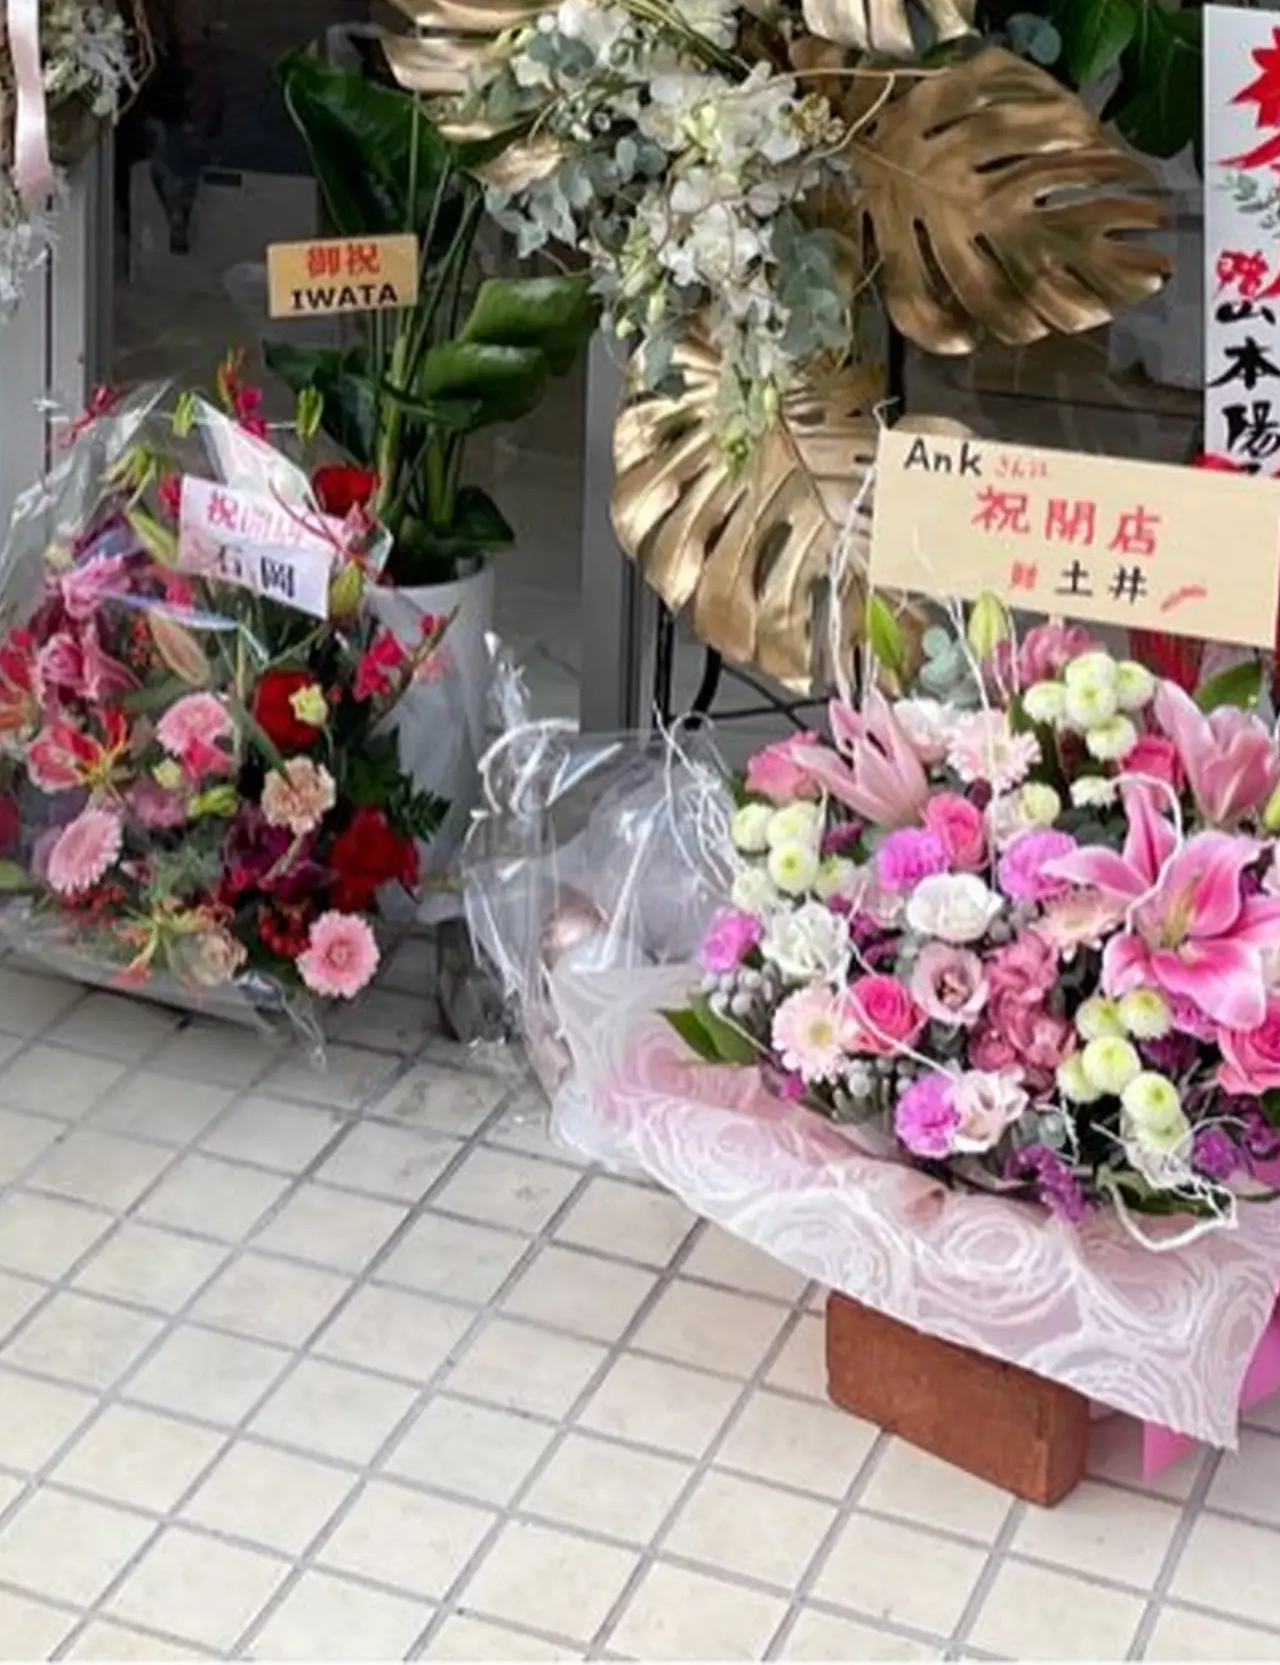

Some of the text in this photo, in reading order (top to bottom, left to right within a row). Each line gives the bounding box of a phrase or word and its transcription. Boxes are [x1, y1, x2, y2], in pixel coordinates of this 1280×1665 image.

[307, 242, 381, 278] 御祝
[292, 282, 398, 311] IWATA
[904, 438, 983, 477] Ank
[1055, 559, 1149, 604] 土井
